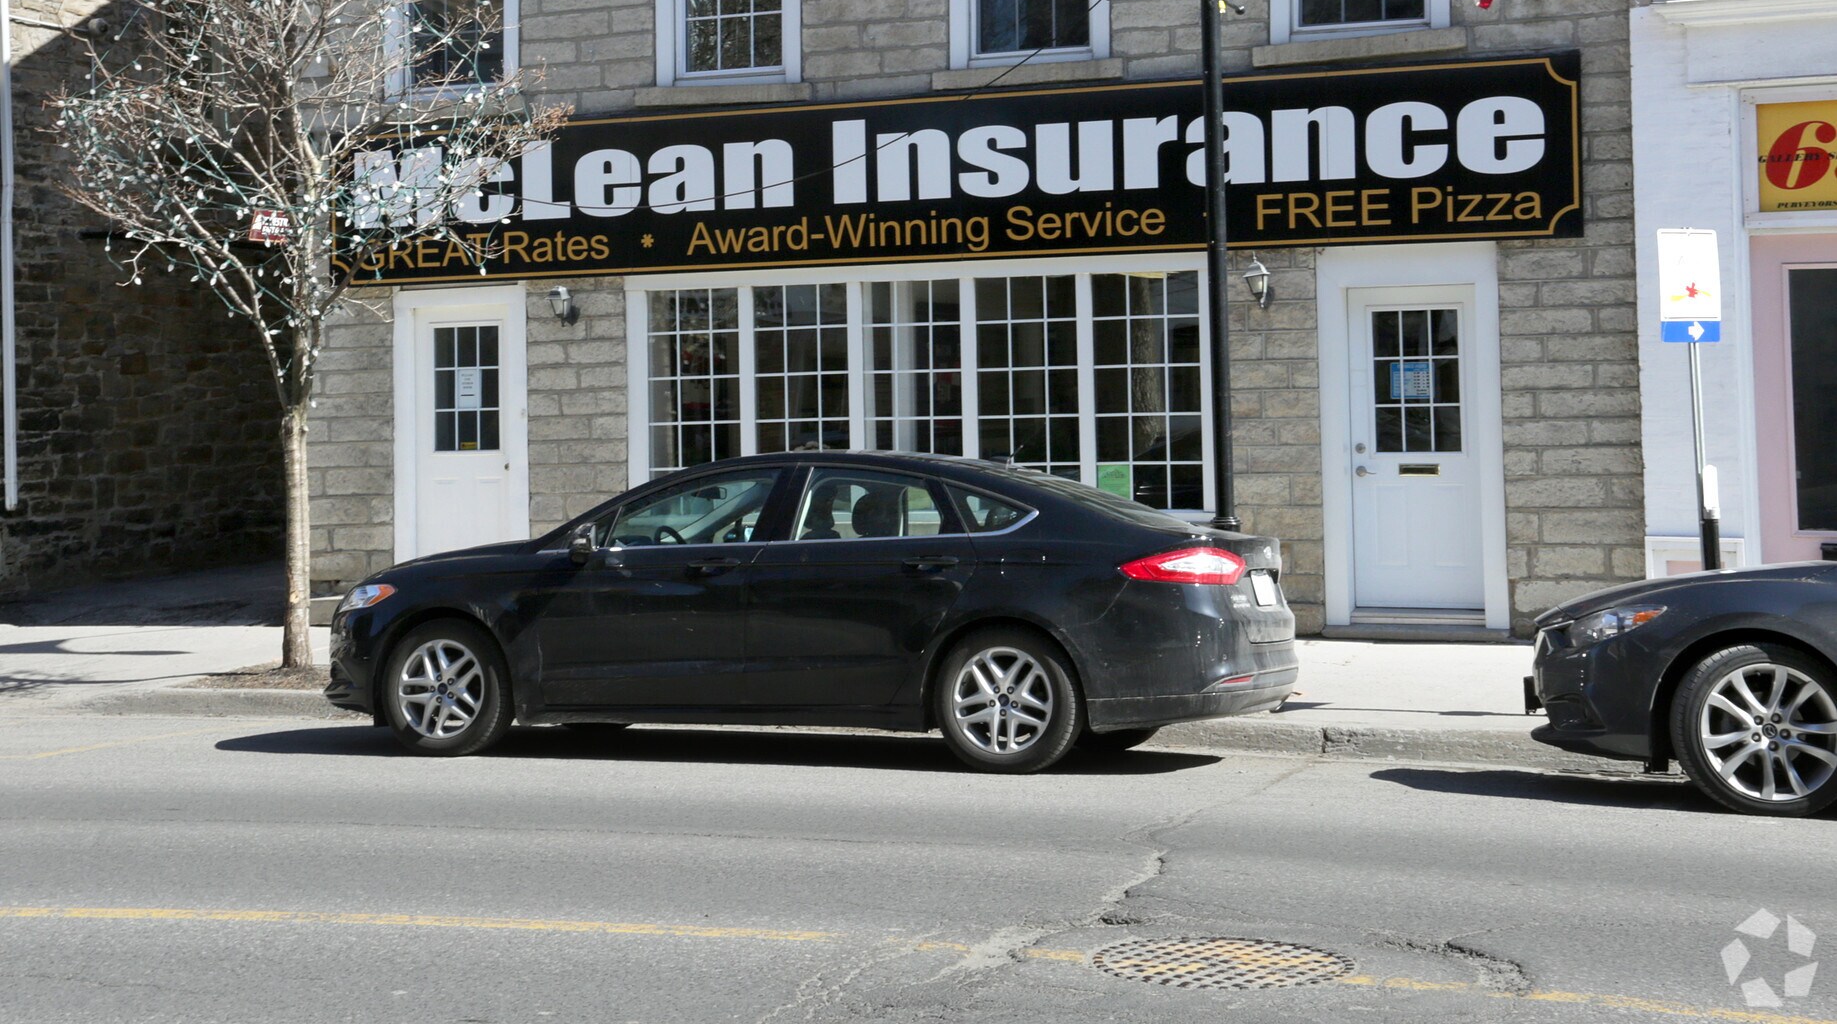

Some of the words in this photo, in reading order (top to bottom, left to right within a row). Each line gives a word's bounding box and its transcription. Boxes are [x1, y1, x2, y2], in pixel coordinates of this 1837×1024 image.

[353, 139, 794, 230] McLean
[832, 96, 1545, 205] Insurance
[357, 232, 490, 272] GREAT
[503, 230, 610, 264] Rates
[687, 210, 990, 253] Award-Winning
[1006, 202, 1166, 241] Service
[1256, 189, 1391, 230] FREE
[1411, 186, 1542, 224] Pizza
